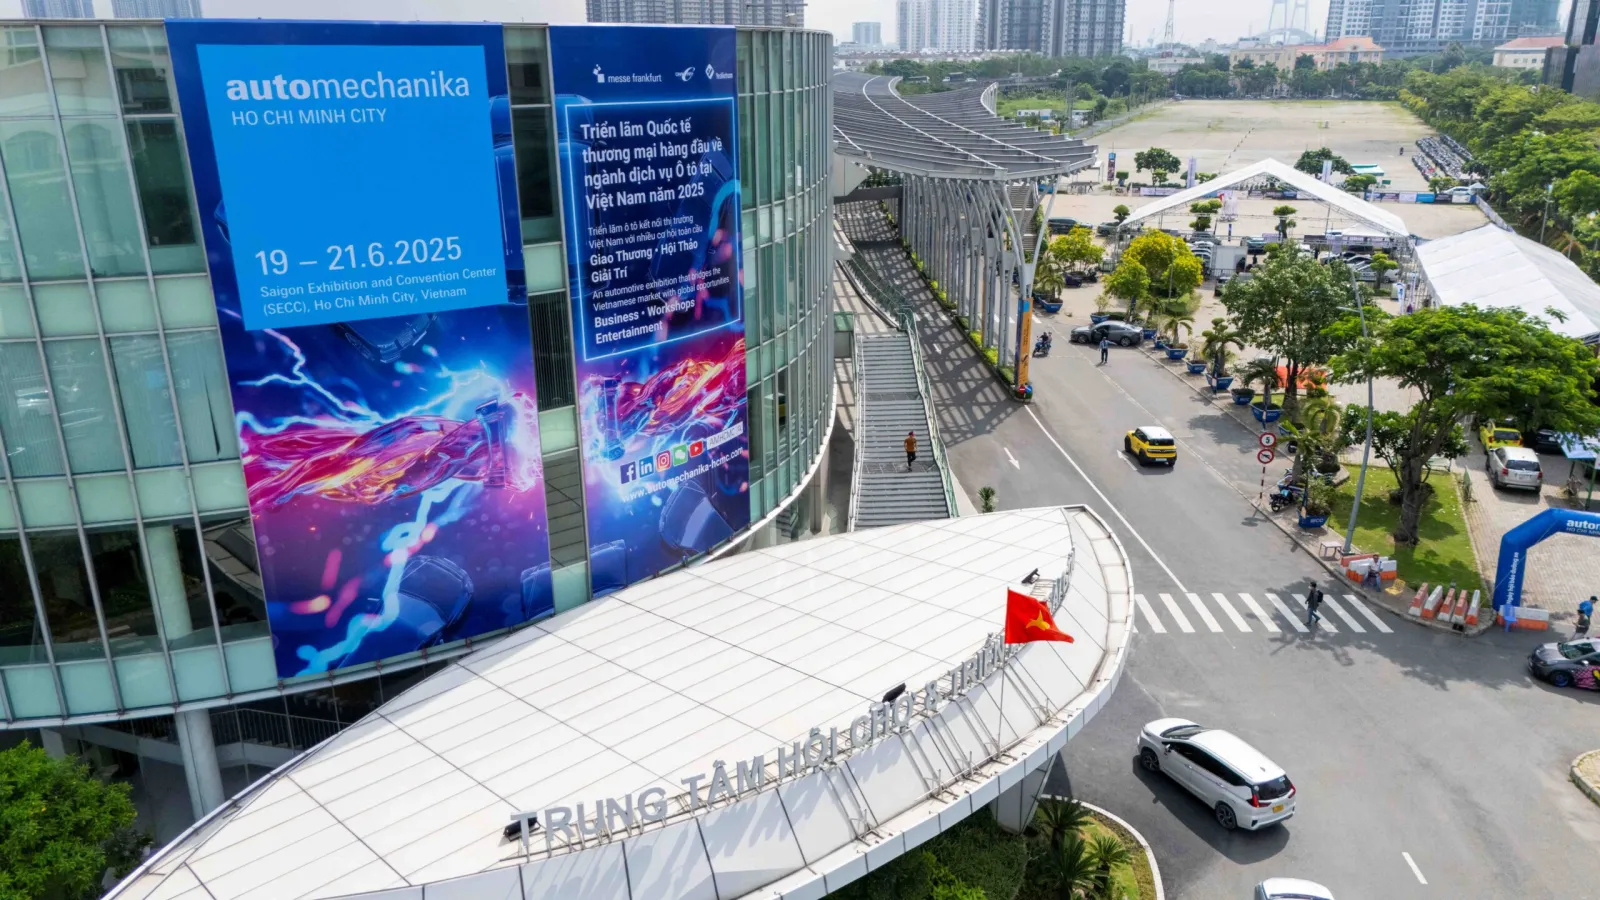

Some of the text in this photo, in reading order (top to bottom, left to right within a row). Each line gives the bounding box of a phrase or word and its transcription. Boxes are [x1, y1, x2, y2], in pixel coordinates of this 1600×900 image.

[226, 70, 470, 101] automechanika
[607, 73, 662, 83] messe frankfurt
[232, 108, 387, 126] HO CHI MINH CITY
[580, 117, 692, 140] Triển lãm Quốc tế
[582, 136, 722, 164] thương mại hàng đầu về
[585, 160, 713, 190] ngành dịch vụ Ô tô tại
[586, 182, 704, 211] Việt Nam năm 2025
[255, 249, 289, 276] 19
[327, 236, 462, 270] 21.6.2025
[588, 239, 604, 250] Việt
[605, 236, 624, 247] Nam
[589, 237, 698, 266] Giao Thương Hội Thảo
[260, 267, 497, 299] Saigon Exhibition and Convention Center
[591, 265, 628, 283] Giải Trí
[592, 266, 721, 299] An automotive exhibition that bridges the
[263, 287, 467, 317] (SECC), Ho Chi Minh City, Vietnam
[593, 276, 730, 312] Vietnamese market with global opportunities
[594, 299, 695, 329] Business Workshops
[595, 320, 663, 345] Entertainment
[1265, 436, 1270, 444] 5
[510, 787, 668, 848] TRUNG
[681, 755, 765, 811] TÂM
[778, 726, 838, 780] HỘI
[849, 691, 916, 747] CHỢ
[924, 680, 941, 711] &
